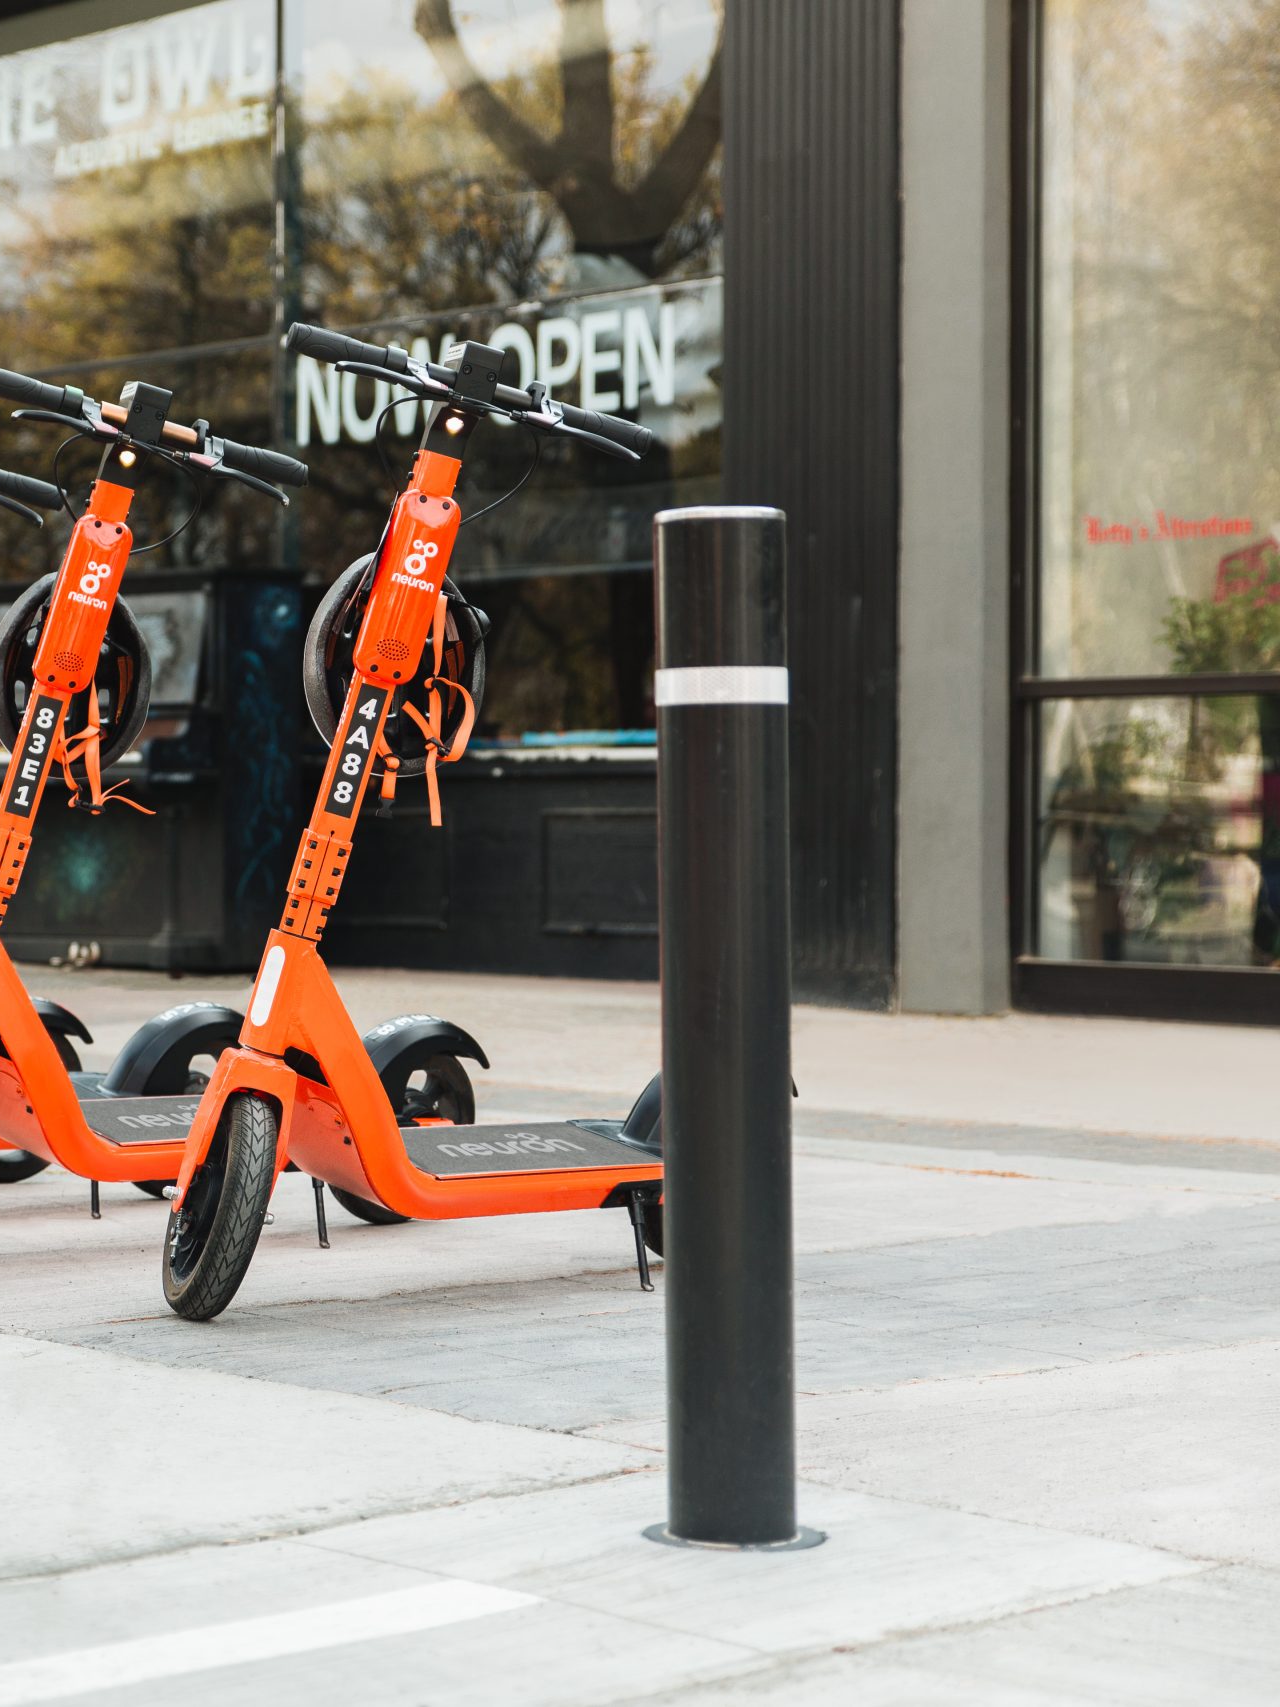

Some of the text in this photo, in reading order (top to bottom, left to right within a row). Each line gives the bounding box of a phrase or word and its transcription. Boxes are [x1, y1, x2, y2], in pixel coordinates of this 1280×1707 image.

[99, 10, 271, 128] OWL
[67, 590, 107, 611] neuron
[391, 572, 435, 593] neuron
[14, 708, 55, 807] 83E1
[333, 698, 378, 804] 4A88
[436, 1136, 587, 1158] neuron
